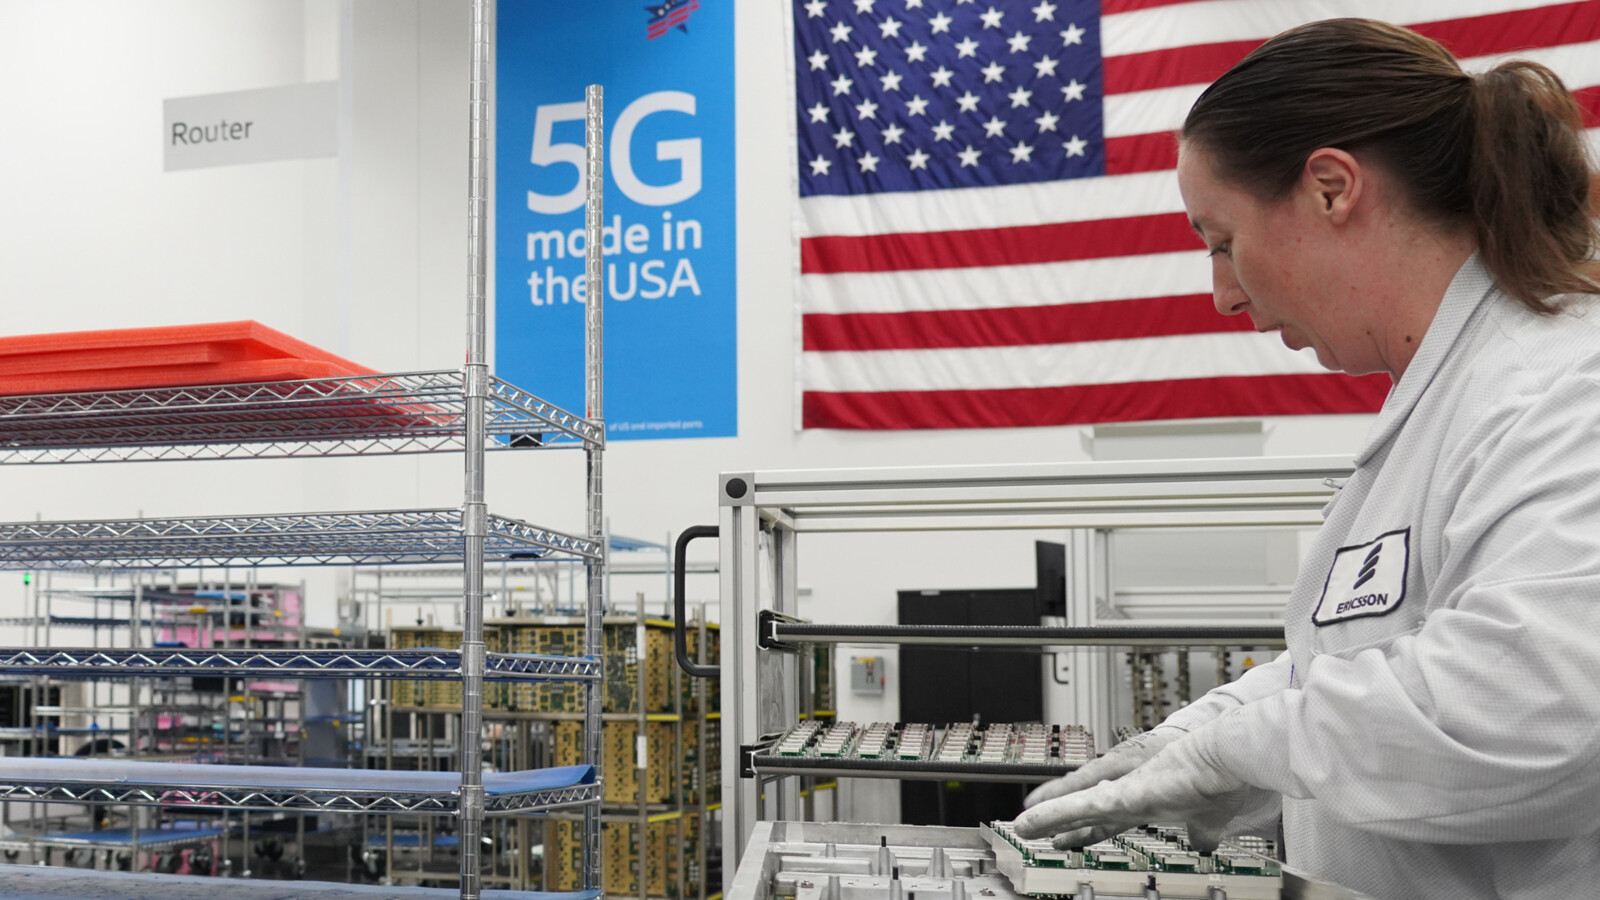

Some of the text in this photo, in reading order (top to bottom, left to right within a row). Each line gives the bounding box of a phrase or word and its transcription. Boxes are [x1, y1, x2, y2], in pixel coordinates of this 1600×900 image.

[172, 120, 253, 146] Router
[527, 90, 702, 215] 5G
[527, 211, 702, 261] made in
[527, 258, 702, 306] the USA
[1336, 593, 1388, 614] ERICSSON
